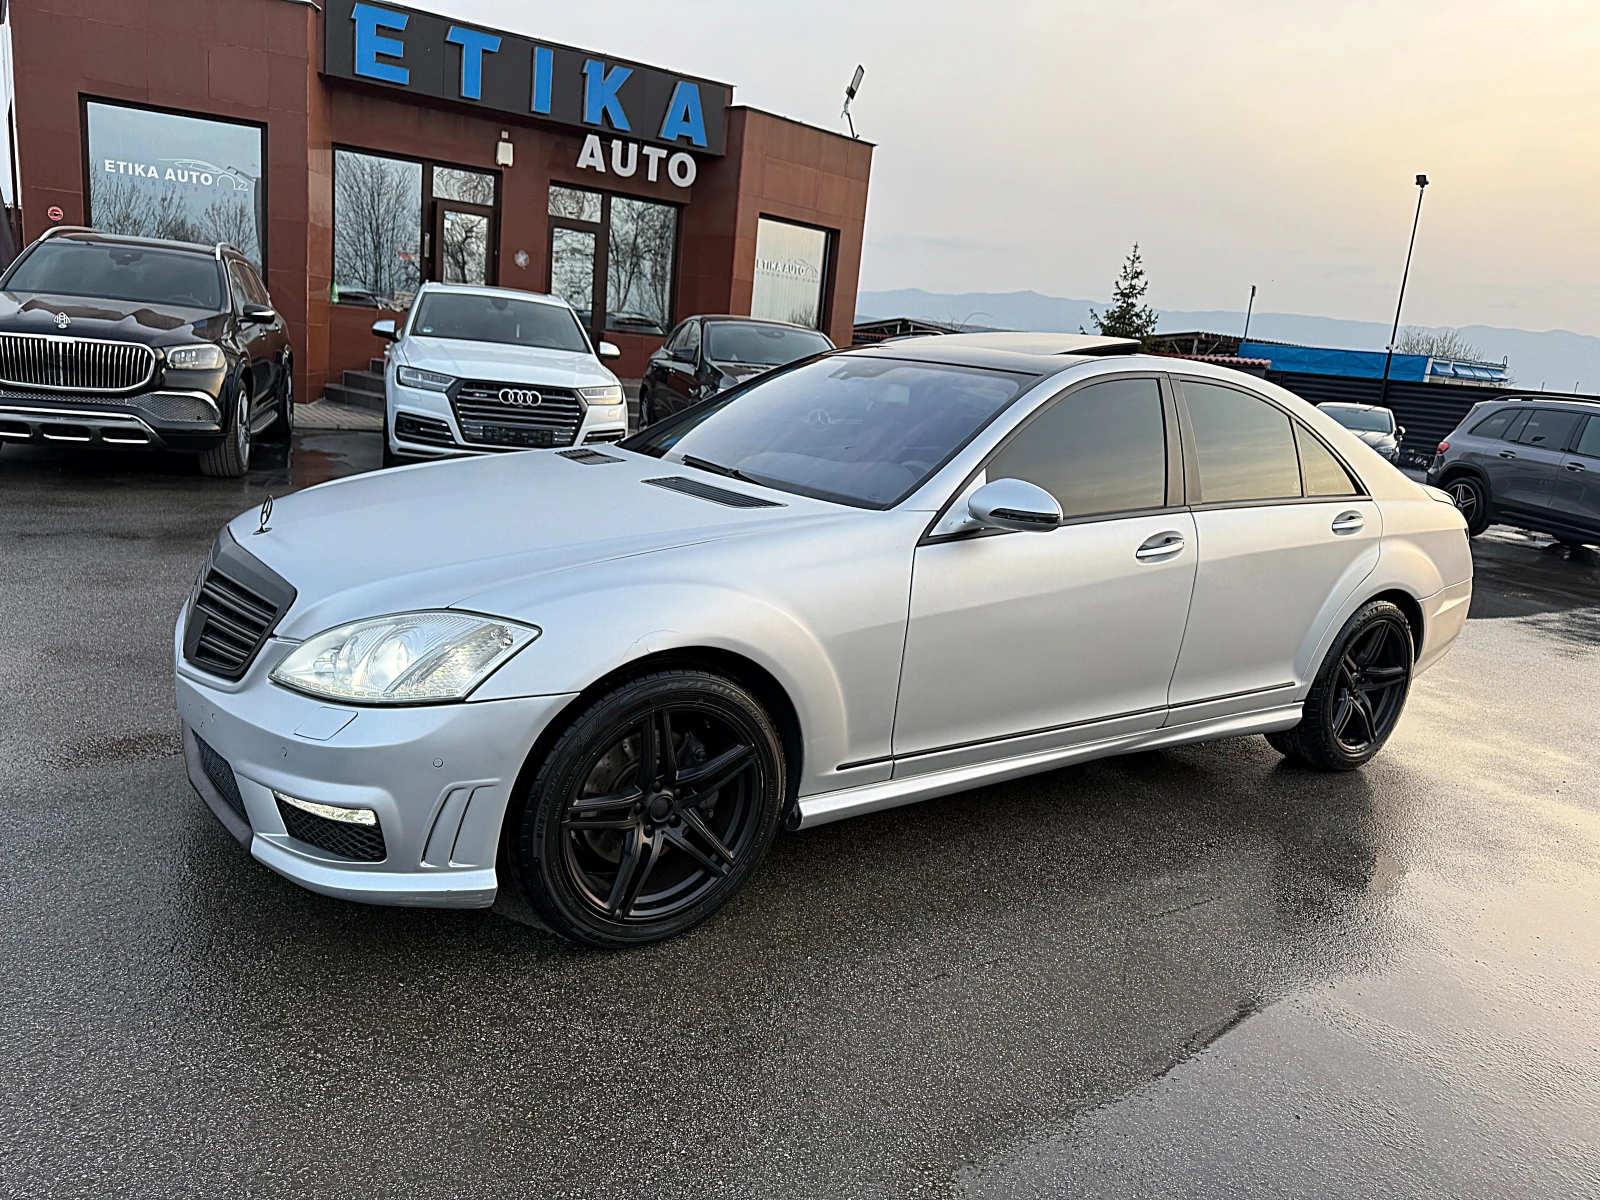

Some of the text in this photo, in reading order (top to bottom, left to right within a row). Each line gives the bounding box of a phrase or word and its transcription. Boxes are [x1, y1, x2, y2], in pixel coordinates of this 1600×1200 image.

[351, 3, 708, 147] ETIKA
[104, 159, 213, 186] ETIKA AUTO
[576, 134, 697, 188] AUTO
[756, 258, 782, 273] ETIKA
[782, 262, 805, 276] AUTO
